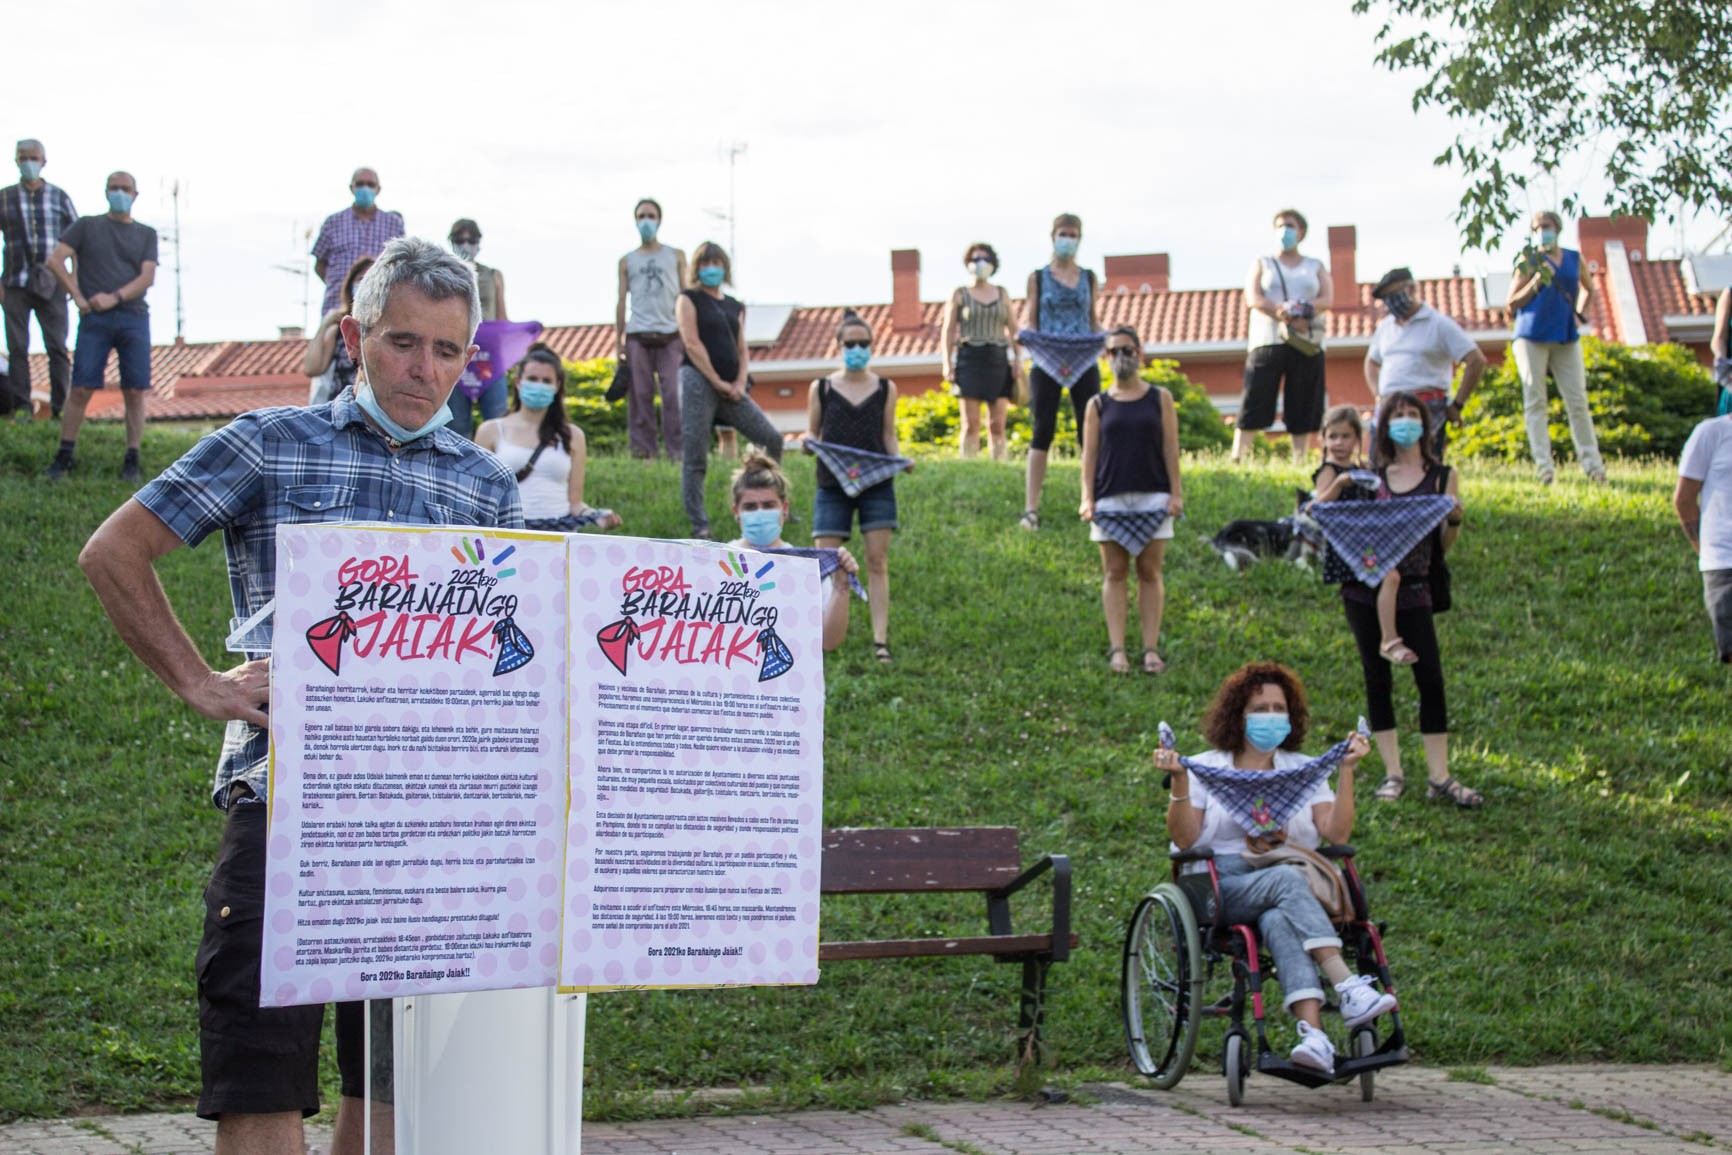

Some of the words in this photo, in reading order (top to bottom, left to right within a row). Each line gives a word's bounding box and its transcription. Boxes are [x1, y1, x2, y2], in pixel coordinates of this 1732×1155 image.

[338, 555, 419, 589] GORA
[622, 566, 692, 599] GORA
[334, 581, 518, 617] BARAÑAINGO
[620, 589, 778, 627] BARAÑAINGO
[353, 610, 497, 664] JAIAK!
[637, 616, 761, 669] JAIAK!
[648, 947, 663, 956] Gora
[664, 947, 686, 956] 2021ko
[687, 947, 721, 957] Barañaingo
[722, 947, 743, 955] Jaiak!!
[360, 972, 377, 981] Gora
[379, 971, 404, 981] 2021ko
[406, 970, 445, 981] Barañaingo
[446, 968, 470, 978] Jaiak!!
